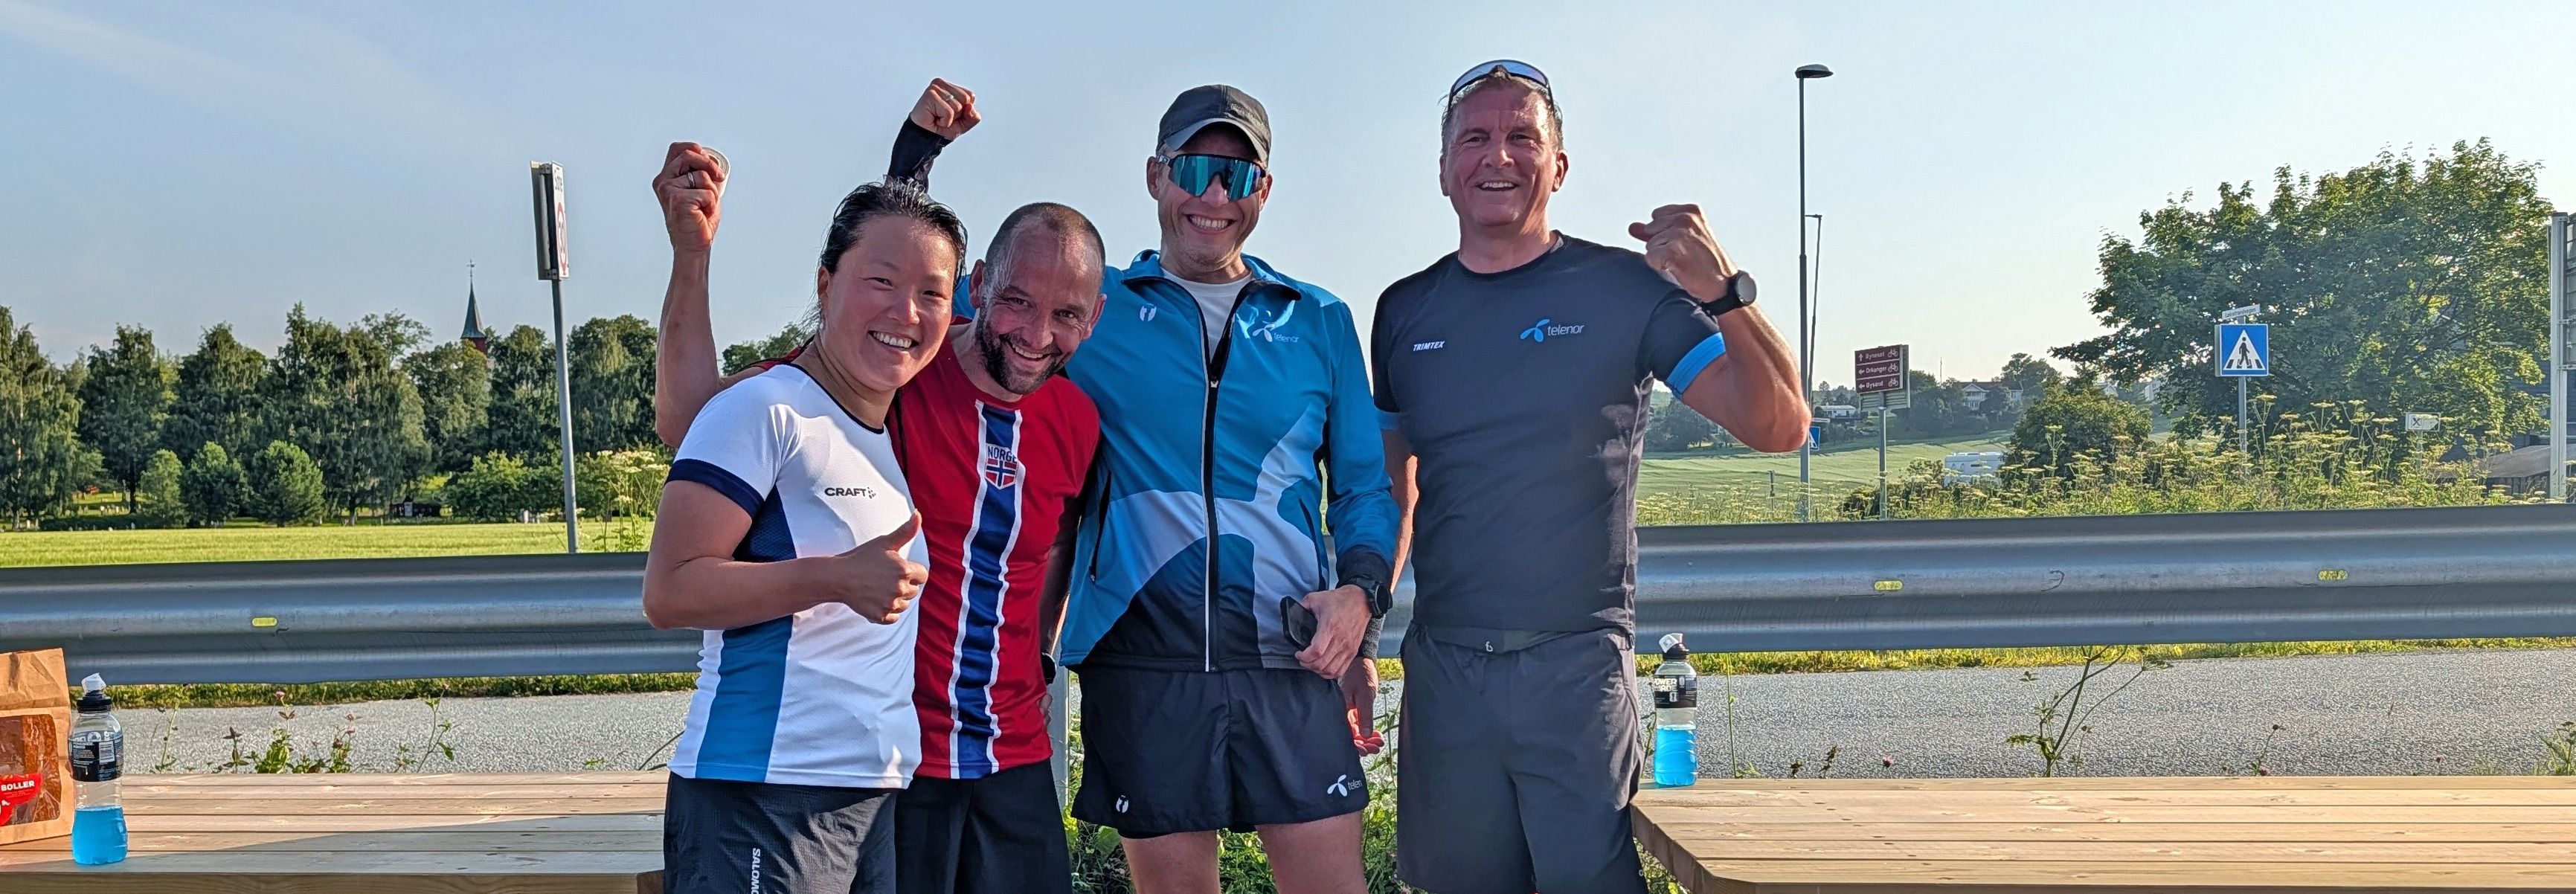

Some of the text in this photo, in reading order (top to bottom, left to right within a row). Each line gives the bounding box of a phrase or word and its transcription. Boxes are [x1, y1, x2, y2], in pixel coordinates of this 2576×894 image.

[1547, 324, 1584, 336] telenor
[1273, 332, 1300, 343] telenor
[1413, 341, 1445, 352] TRIMTEX
[824, 487, 867, 497] CRAFT
[1, 780, 35, 791] BOLLER
